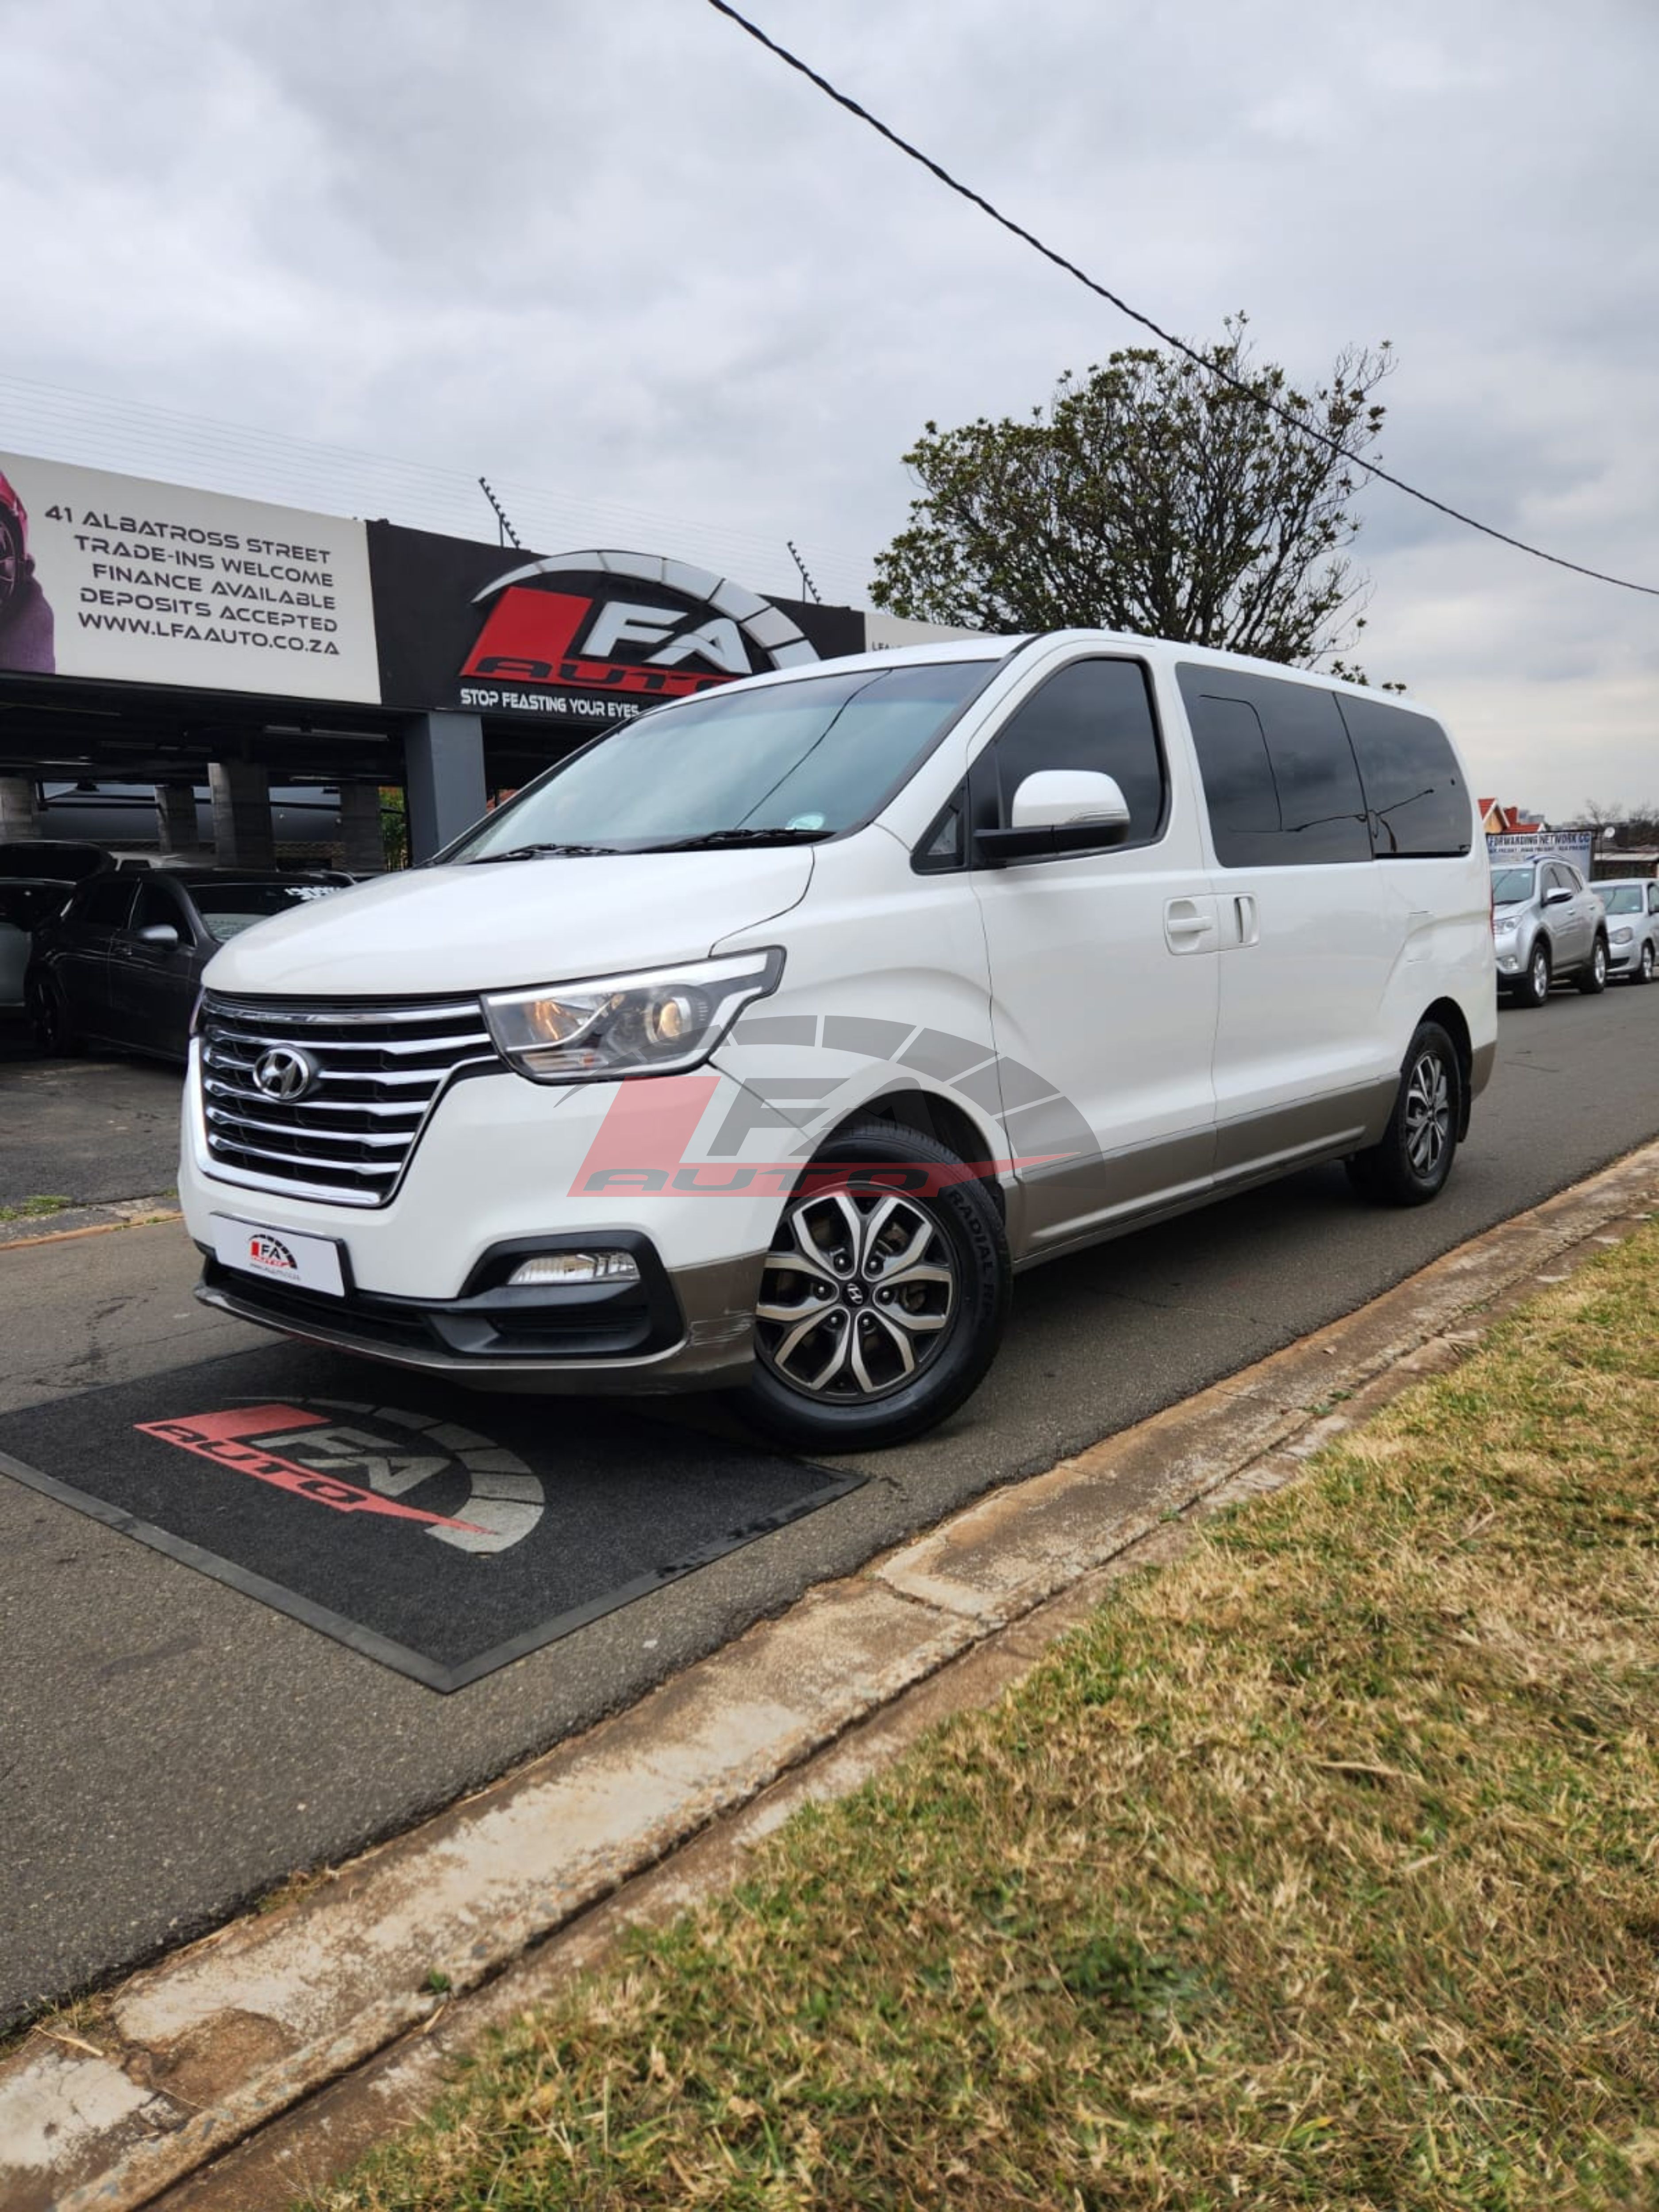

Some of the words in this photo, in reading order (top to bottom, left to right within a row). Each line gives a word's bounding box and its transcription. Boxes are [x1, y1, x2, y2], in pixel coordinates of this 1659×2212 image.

[45, 505, 72, 523] 41
[82, 511, 239, 550] ALBATROSS
[246, 538, 331, 564] STREET
[74, 535, 215, 569] TRADE-INS
[222, 557, 334, 587] WELCOME
[80, 587, 211, 617] DEPOSITS
[219, 605, 338, 632] ACCEPTED
[92, 563, 203, 592] FINANCE
[211, 581, 336, 610] AVAILABLE
[78, 612, 340, 655] WWW.LFAAUTO.CO.ZA
[460, 688, 499, 706] STOP
[502, 692, 566, 713] FEASTING
[569, 698, 605, 716] YOUR
[608, 702, 639, 719] EYES
[1539, 833, 1576, 845] NETWORK
[947, 1189, 993, 1273] RADIAL
[149, 1423, 370, 1504] AUTO
